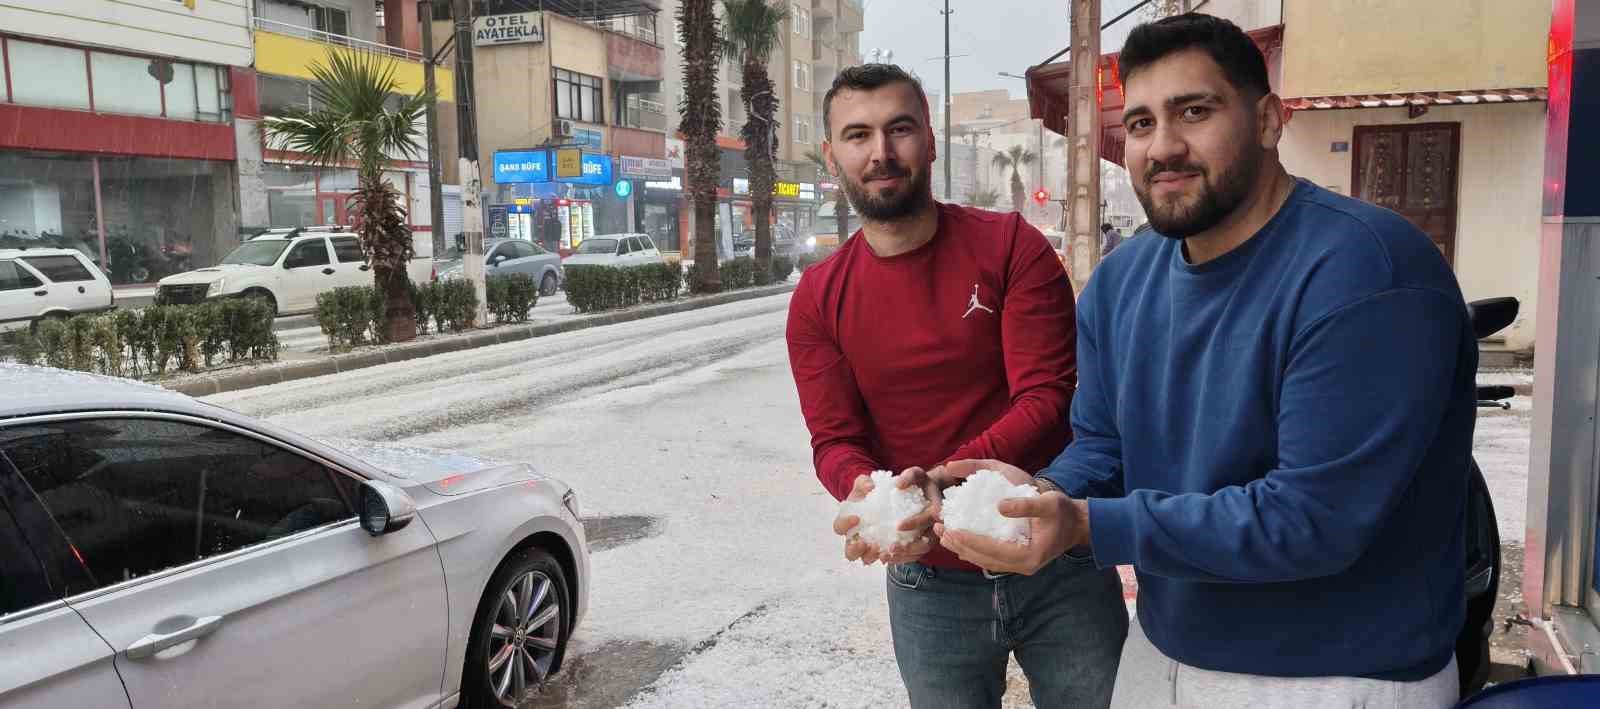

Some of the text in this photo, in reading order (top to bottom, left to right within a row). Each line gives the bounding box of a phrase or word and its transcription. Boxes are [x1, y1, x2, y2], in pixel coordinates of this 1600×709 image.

[486, 15, 528, 27] OTEL
[477, 25, 539, 40] AYATEKLA
[521, 161, 541, 171] BÜFE
[583, 161, 602, 175] BÜFE
